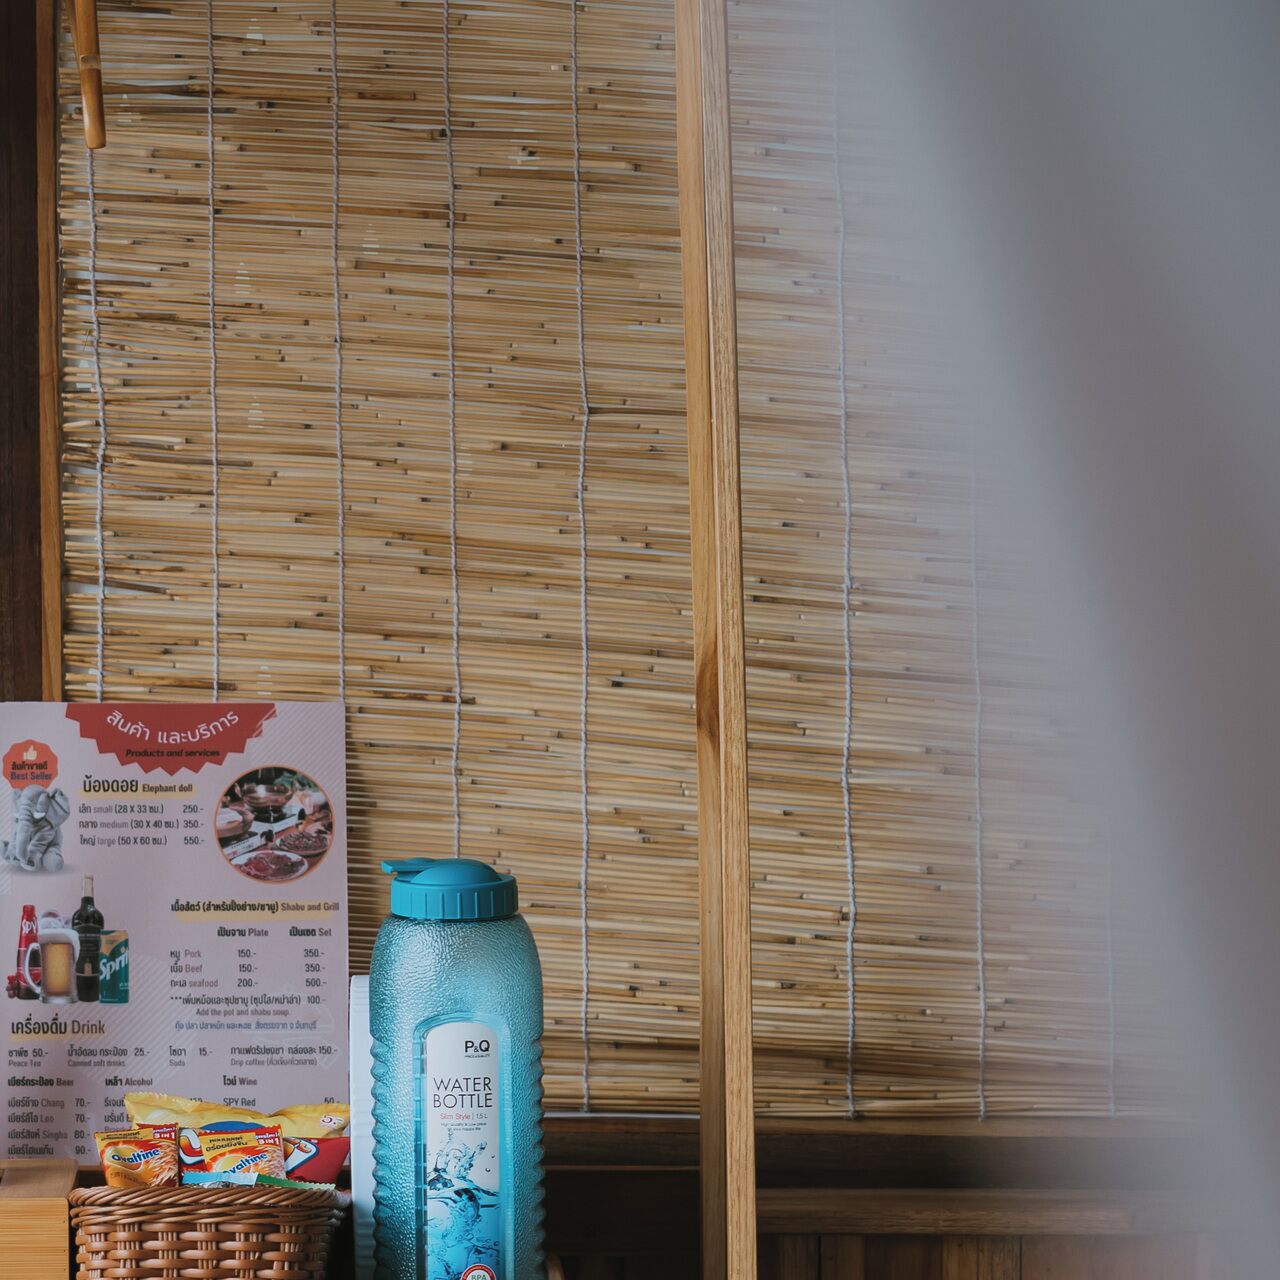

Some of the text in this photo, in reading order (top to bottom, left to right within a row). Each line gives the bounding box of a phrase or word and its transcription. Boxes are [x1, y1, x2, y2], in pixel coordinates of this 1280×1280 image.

[106, 709, 240, 744] สินค้า และบริการ
[125, 749, 220, 757] Products and services
[11, 771, 52, 780] Best Seller
[83, 774, 193, 794] น้องดอย Elephant doll
[93, 805, 113, 813] small
[114, 804, 128, 814] (28
[137, 804, 148, 813] 33
[100, 819, 129, 829] medium
[130, 819, 144, 829] (30
[153, 820, 162, 828] 40
[97, 836, 117, 847] large
[118, 836, 132, 846] (50
[140, 836, 151, 845] 60
[281, 902, 305, 911] Shabu
[307, 902, 321, 911] and
[323, 902, 340, 911] Grill
[248, 928, 269, 937] Plate
[318, 928, 332, 937] Set
[170, 951, 181, 962] หมู
[184, 950, 202, 958] Pork
[185, 964, 203, 973] Beef
[189, 978, 219, 988] seafood
[196, 1008, 289, 1018] Add the pot and shabu soup
[11, 1013, 106, 1035] เครื่องดื่ม Drink
[464, 1039, 491, 1053] P&Q
[230, 1058, 244, 1067] Drip
[245, 1058, 265, 1066] coffee
[56, 1078, 74, 1086] Beer
[124, 1078, 153, 1086] Alcohol
[238, 1077, 258, 1086] Wine
[433, 1076, 492, 1092] WATER
[40, 1099, 65, 1109] Chang
[223, 1097, 256, 1106] SPY Red
[433, 1093, 493, 1109] BOTTLE
[40, 1115, 55, 1123] Leo
[440, 1112, 454, 1120] Slim
[455, 1112, 471, 1120] Style
[42, 1130, 68, 1141] Singha
[111, 1147, 160, 1164] Ovaltine
